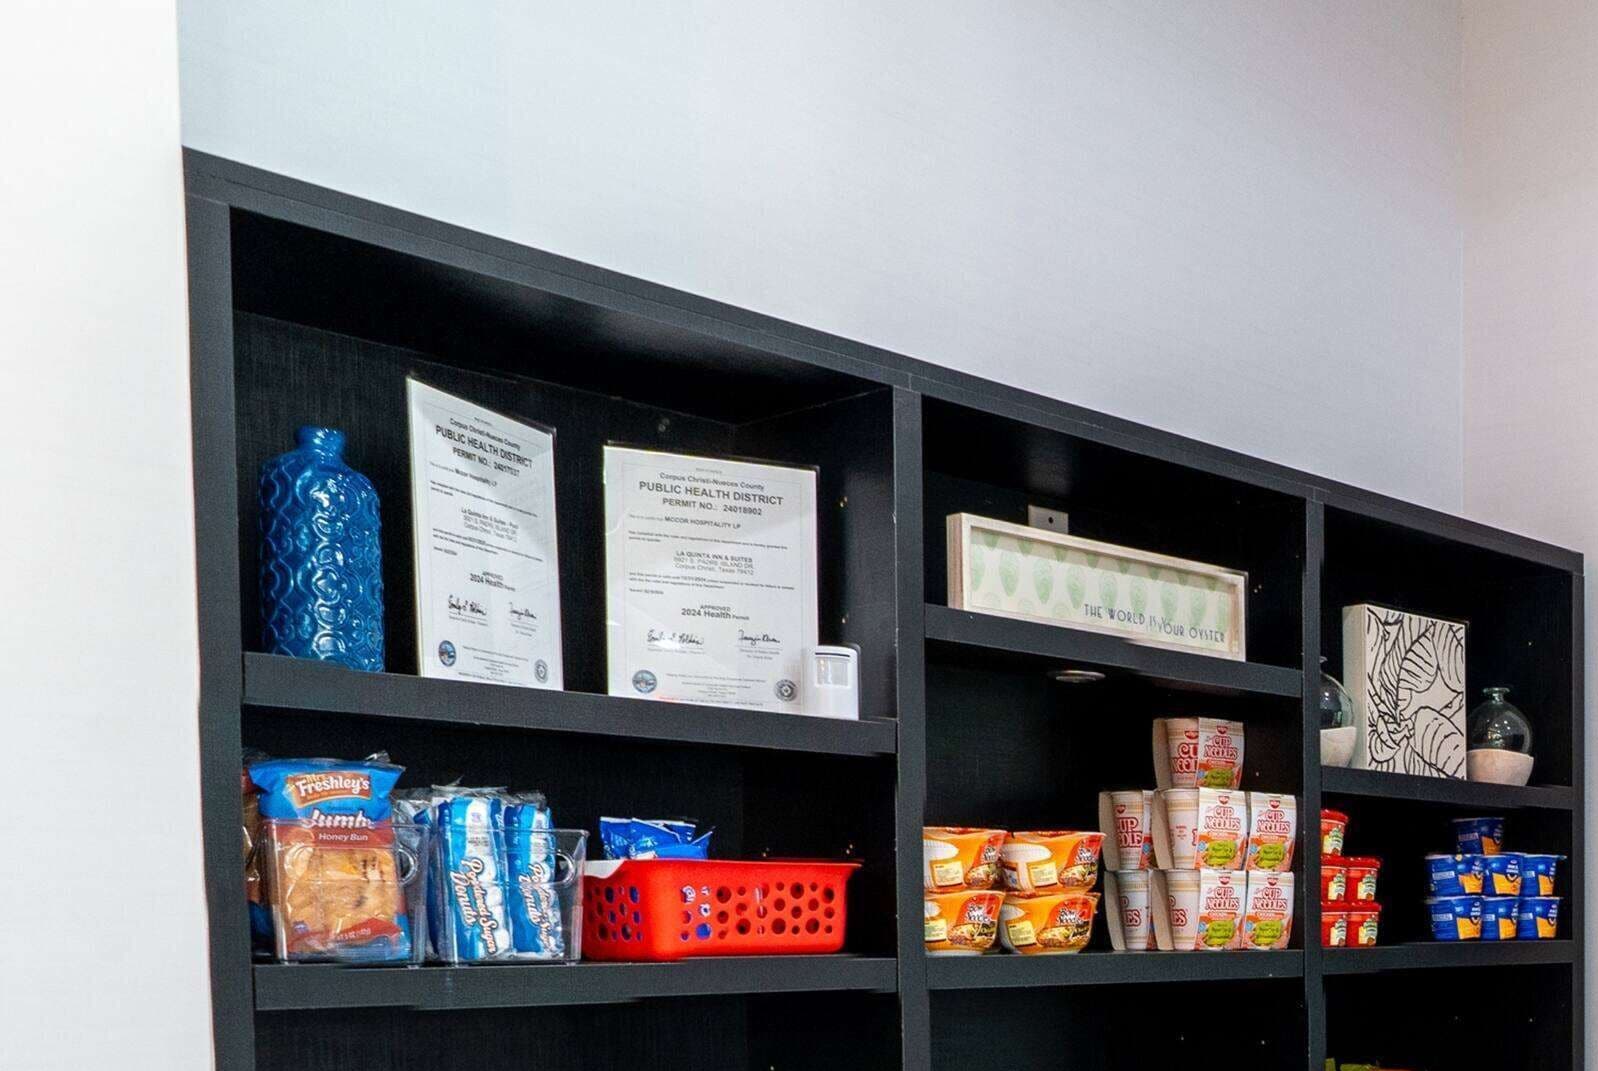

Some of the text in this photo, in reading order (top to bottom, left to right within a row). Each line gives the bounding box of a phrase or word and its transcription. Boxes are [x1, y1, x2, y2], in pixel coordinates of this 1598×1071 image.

[435, 425, 532, 468] PUBLIC HEALTH DISTRICT
[453, 447, 476, 462] PERMIT
[659, 472, 686, 482] Corpus
[740, 481, 765, 492] County
[639, 481, 784, 506] PUBLIC HEALTH DISTRICT
[662, 497, 697, 509] PERMIT
[681, 608, 701, 617] 2024
[704, 610, 732, 619] Health
[1083, 603, 1103, 619] THE
[1107, 609, 1145, 625] WORLD
[1159, 618, 1184, 637] YOUR
[1189, 627, 1225, 643] OYSTER
[295, 775, 370, 797] Freshley's
[319, 832, 369, 842] Honey Bun
[450, 870, 478, 927] Donuts
[1206, 897, 1240, 910] NOODLES
[1252, 898, 1288, 911] NOODLES
[479, 914, 499, 954] Sugar
